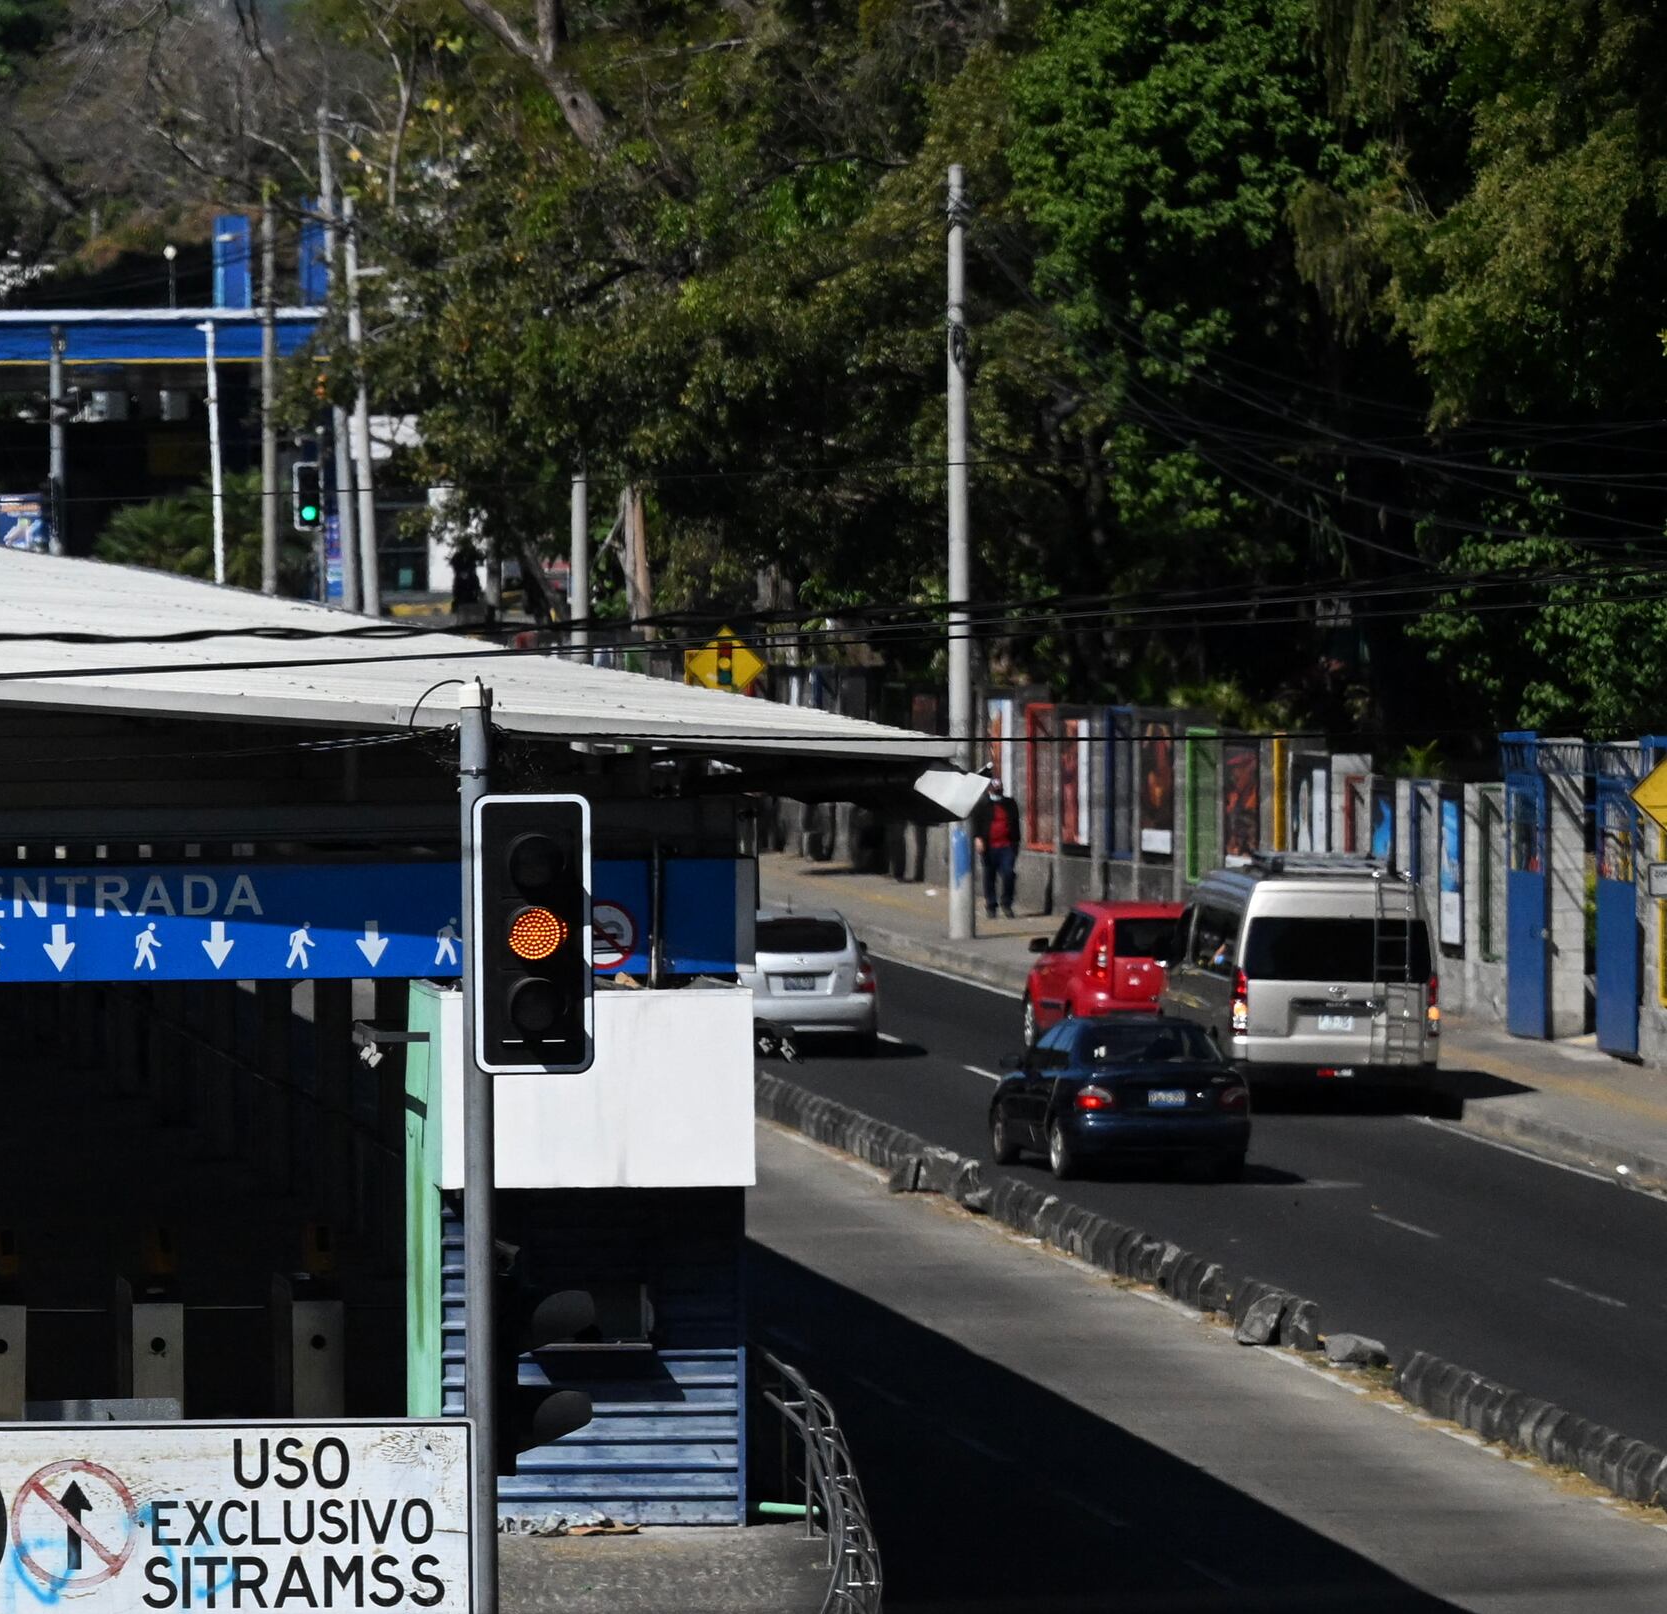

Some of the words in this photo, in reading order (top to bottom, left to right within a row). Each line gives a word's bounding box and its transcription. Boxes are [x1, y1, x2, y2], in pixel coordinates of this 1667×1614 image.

[233, 1437, 351, 1490] USO
[151, 1498, 435, 1547] EXCLUSIVO
[142, 1554, 446, 1610] SITRAMSS
